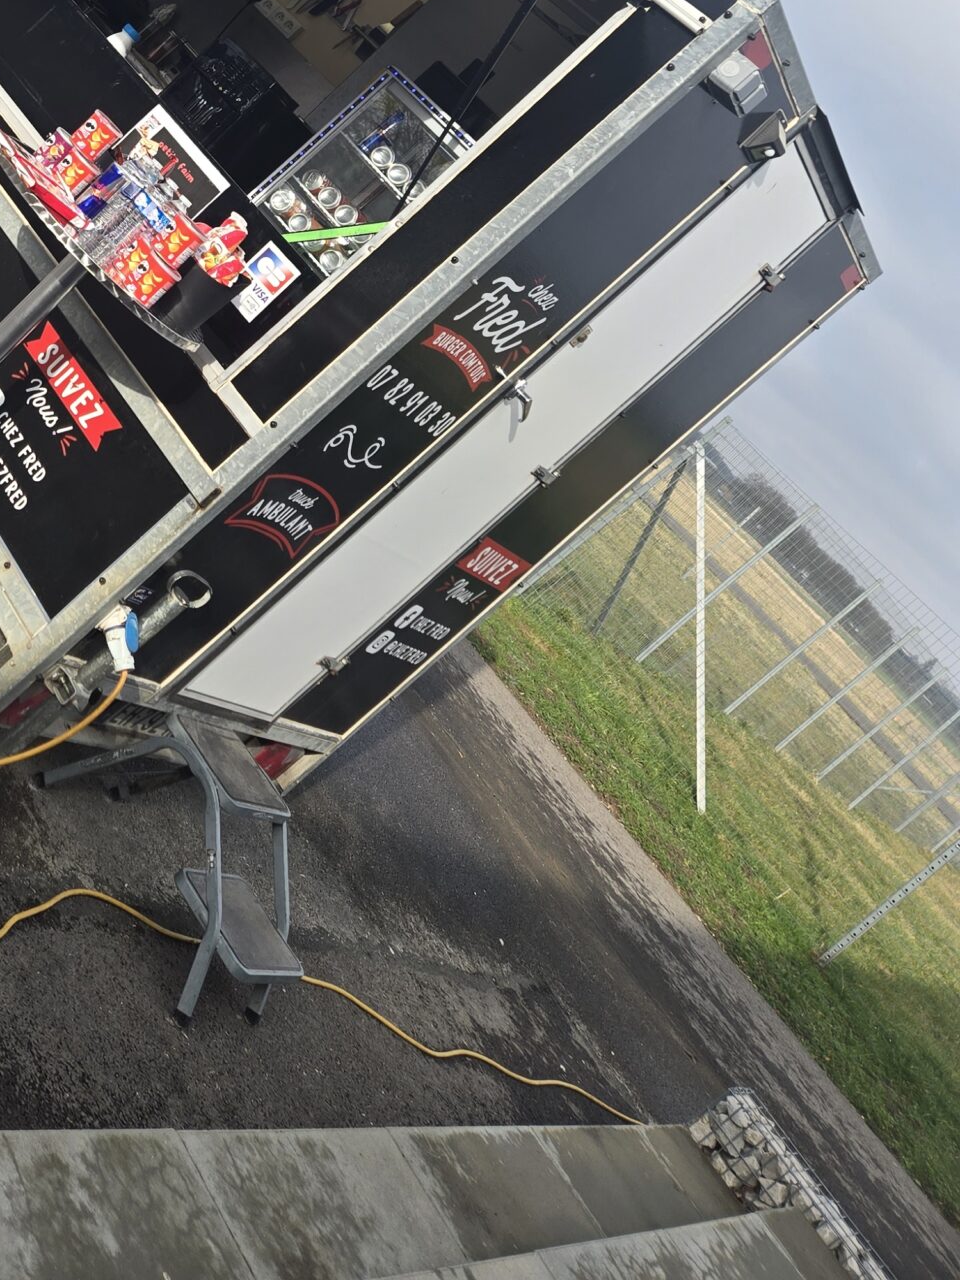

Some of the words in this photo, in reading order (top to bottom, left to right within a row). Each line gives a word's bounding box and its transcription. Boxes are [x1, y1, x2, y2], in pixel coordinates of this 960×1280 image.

[177, 162, 194, 183] faim
[252, 283, 269, 304] VISA
[527, 283, 559, 311] chez
[453, 276, 547, 353] Fred
[432, 331, 467, 361] BURGER
[459, 349, 487, 383] COMTOIS
[37, 343, 104, 429] SUIVEZ
[366, 364, 399, 391] 07
[383, 377, 415, 405] 82
[399, 391, 430, 417] 91
[413, 401, 442, 426] 03
[427, 411, 456, 437] 30
[18, 445, 47, 482] FRED
[288, 488, 319, 509] truck
[246, 499, 313, 540] AMBULANT
[466, 546, 519, 585] SUIVEZ
[410, 616, 435, 634] CHEZ
[426, 623, 451, 640] FRED
[383, 640, 428, 665] @CHEZFRED
